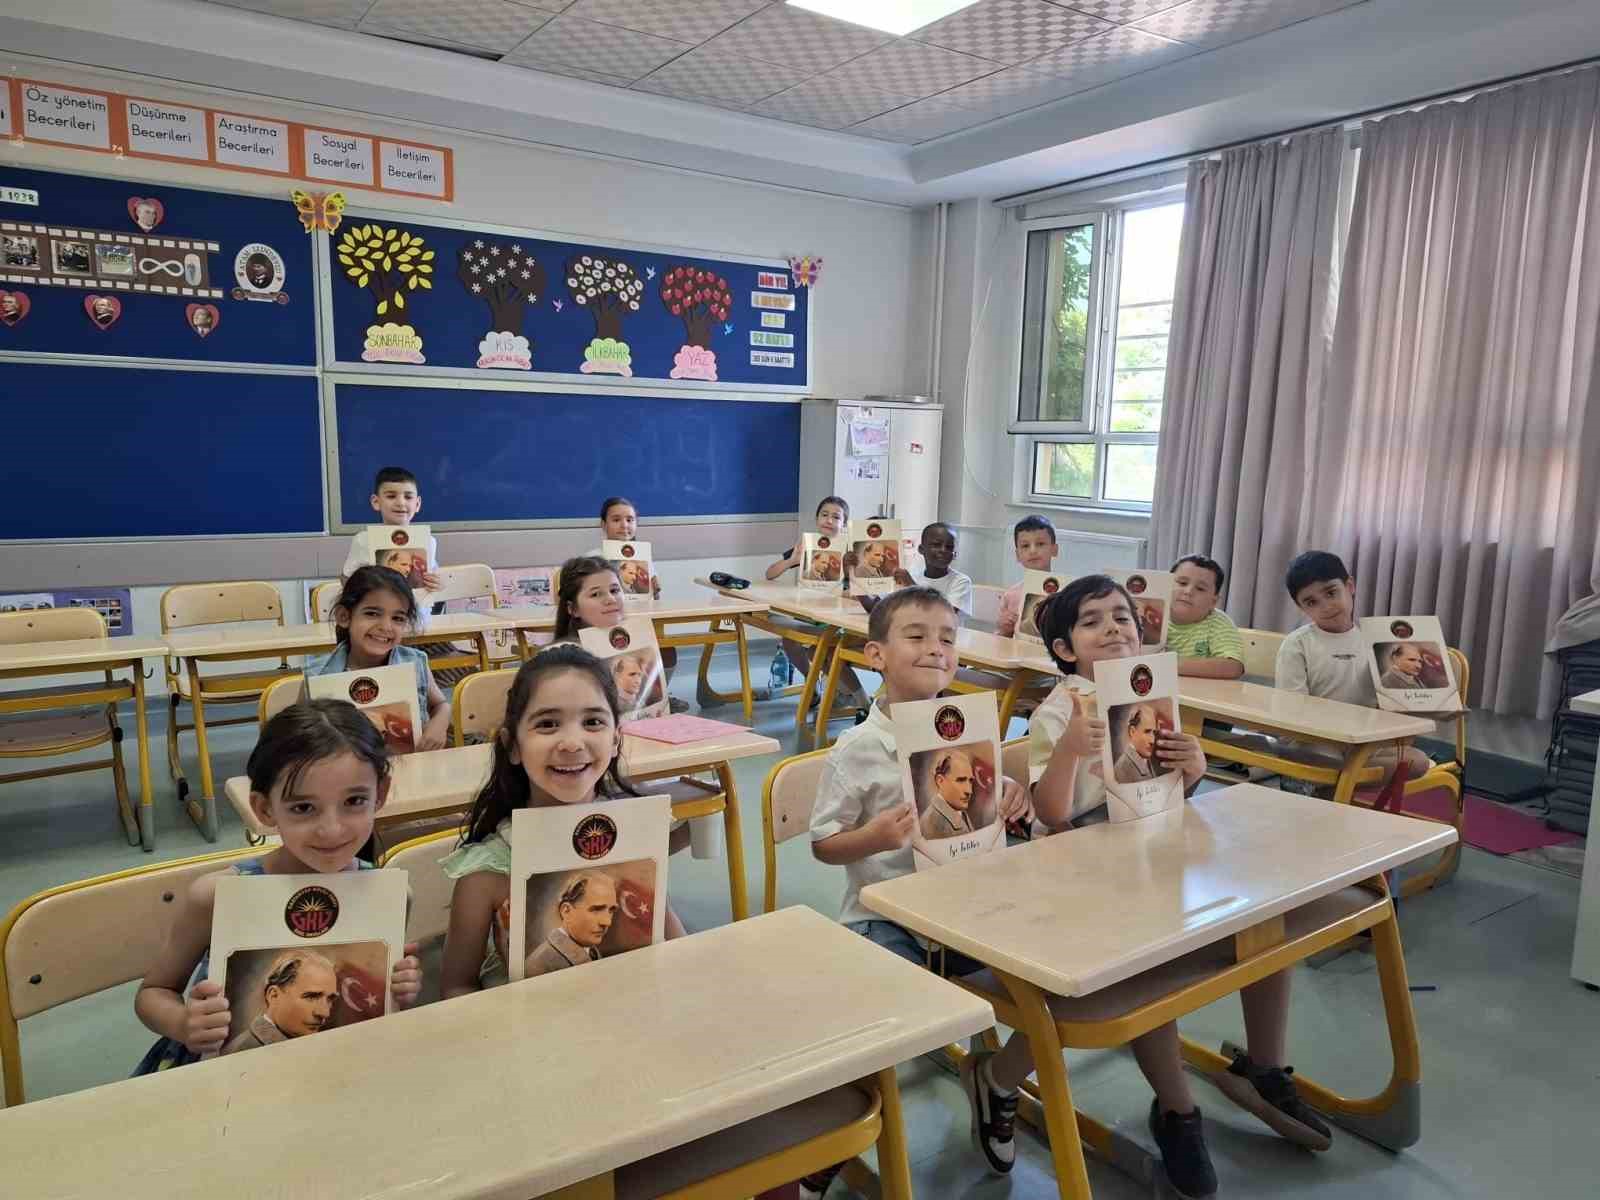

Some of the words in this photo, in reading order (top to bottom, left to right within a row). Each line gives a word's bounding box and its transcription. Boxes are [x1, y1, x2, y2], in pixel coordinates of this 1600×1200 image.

[26, 86, 49, 102] Öz
[54, 96, 106, 113] yönetim
[27, 109, 96, 132] Becerileri
[129, 103, 187, 122] Düşünme
[131, 124, 192, 144] Becerileri
[218, 117, 278, 137] Araştırma
[218, 137, 274, 156] Becerileri
[321, 135, 358, 153] Sosyal
[312, 152, 365, 171] Becerileri
[387, 165, 437, 182] Becerileri
[688, 351, 711, 366] YAZ
